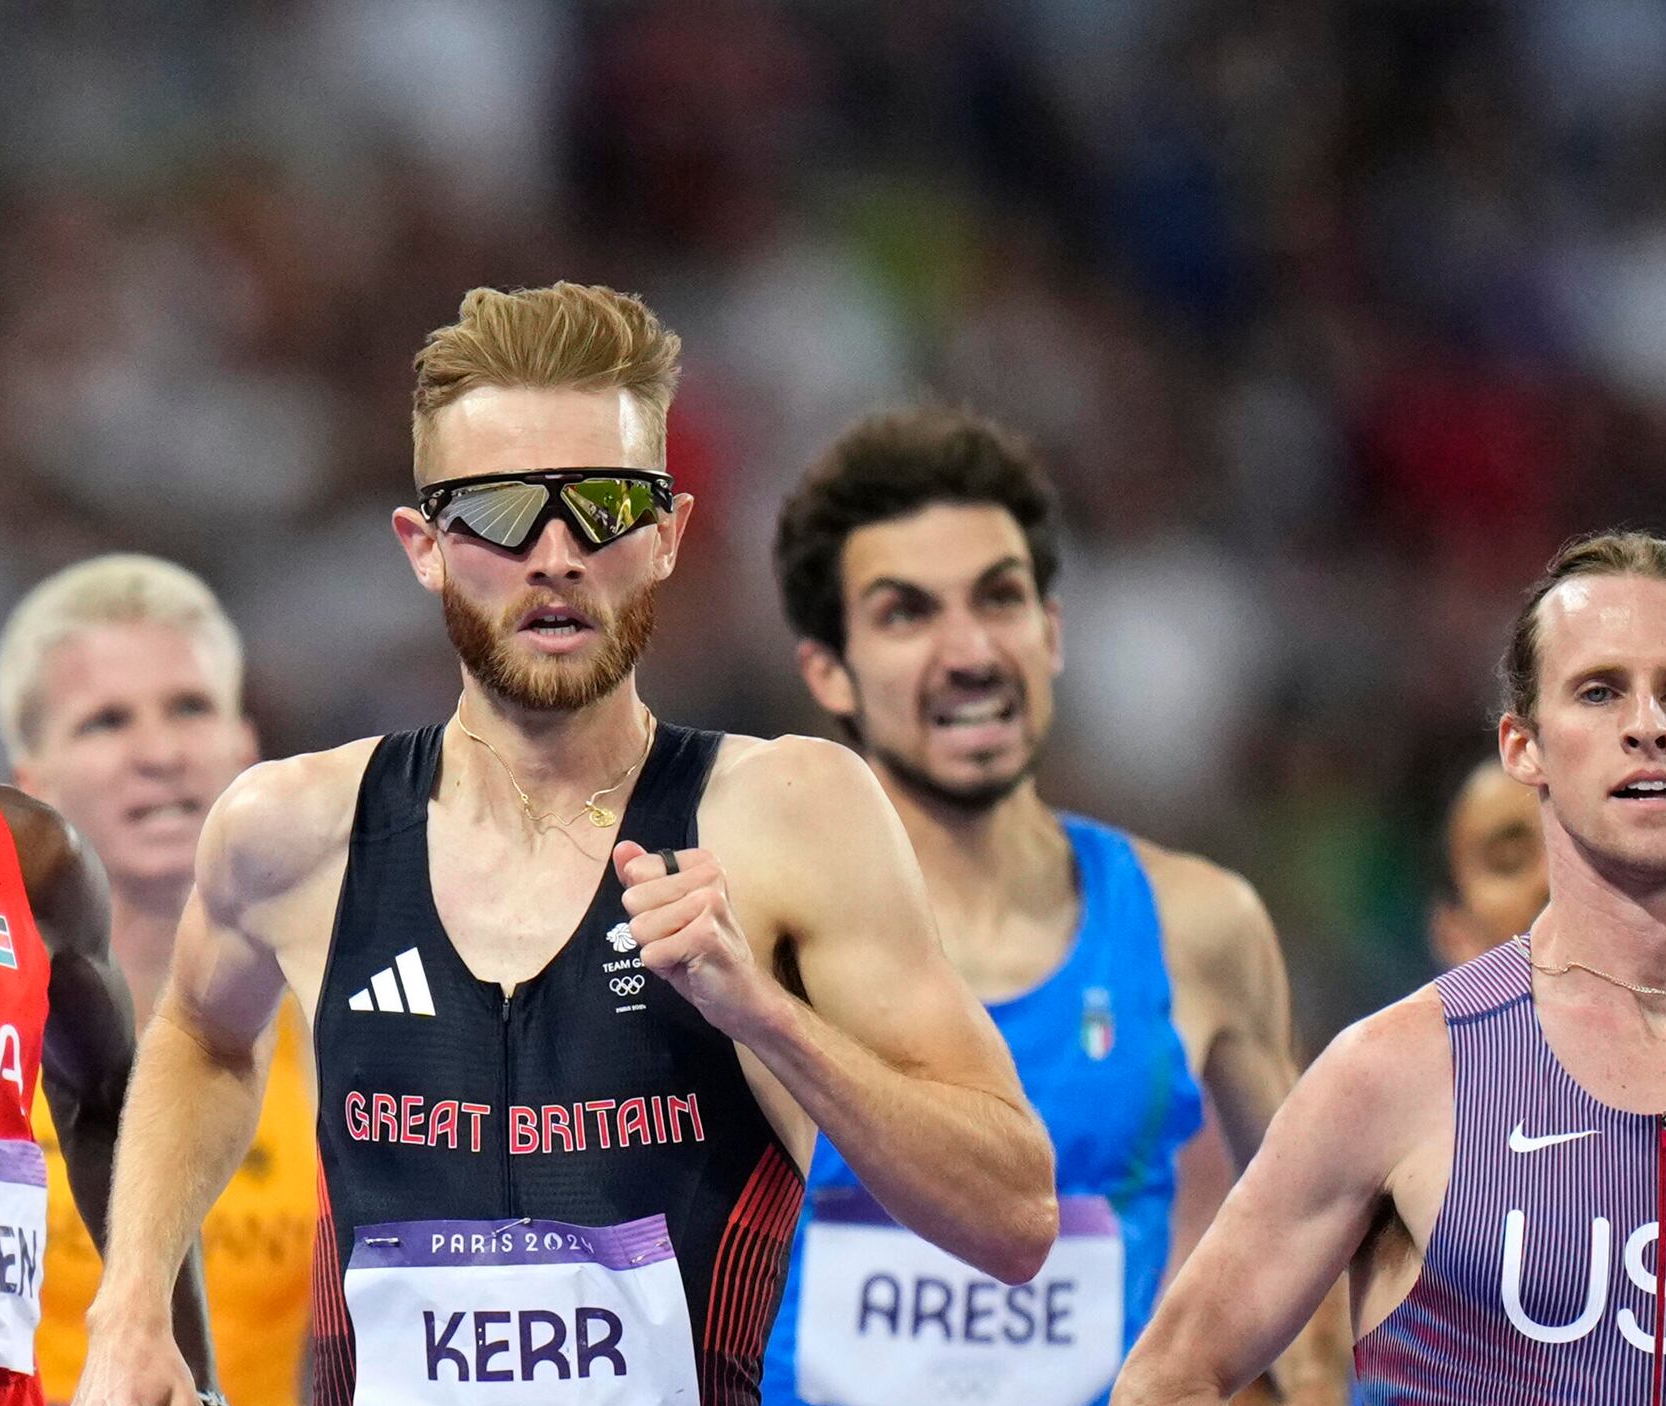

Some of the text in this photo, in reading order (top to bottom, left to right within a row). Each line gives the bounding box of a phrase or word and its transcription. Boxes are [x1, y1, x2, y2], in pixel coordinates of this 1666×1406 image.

[602, 959, 631, 973] TEAM
[344, 1090, 705, 1155] GREAT BRITAIN
[432, 1231, 594, 1254] PARIS 2024
[856, 1271, 1076, 1345] ARESE
[423, 1307, 627, 1382] KERR
